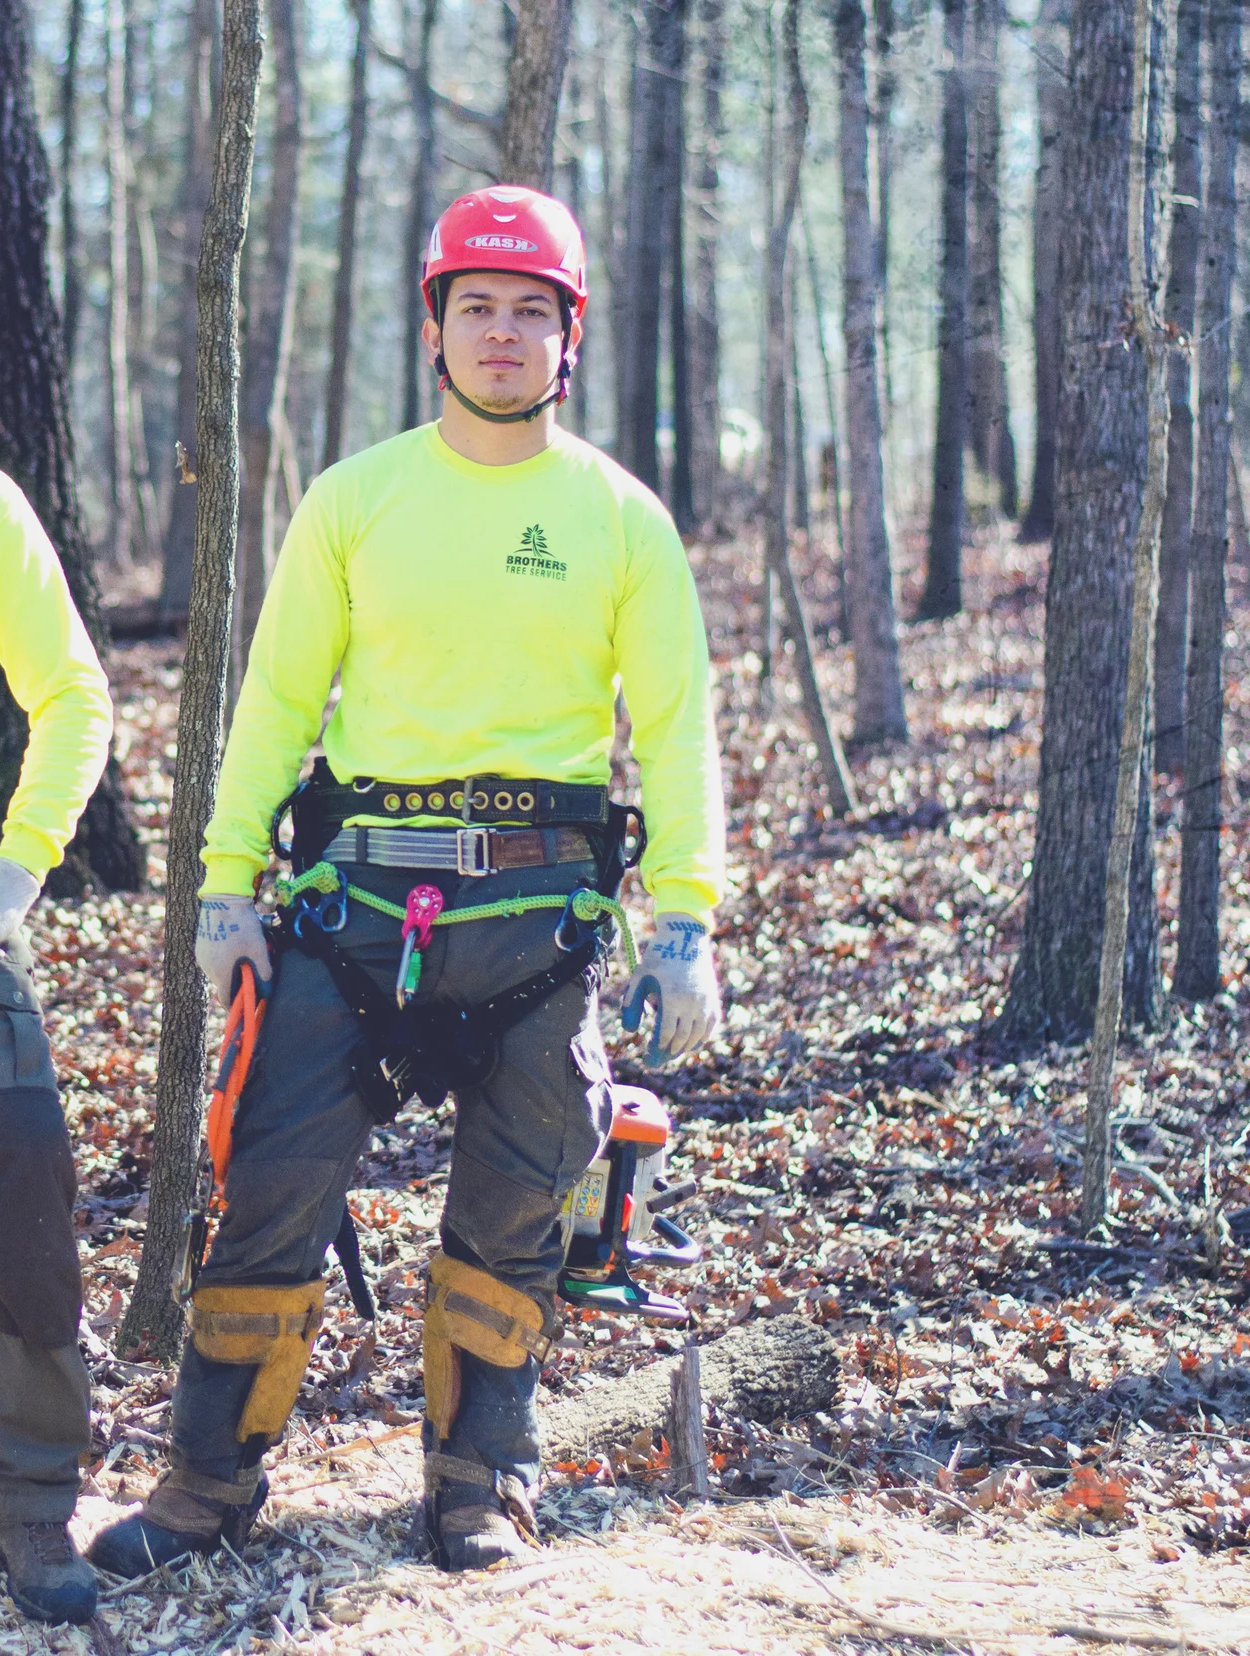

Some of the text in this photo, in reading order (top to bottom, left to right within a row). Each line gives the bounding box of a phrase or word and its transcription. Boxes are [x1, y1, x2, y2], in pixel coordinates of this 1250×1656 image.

[475, 237, 529, 251] KASK
[506, 555, 567, 572] BROTHERS
[505, 565, 567, 582] TREE SERVICE
